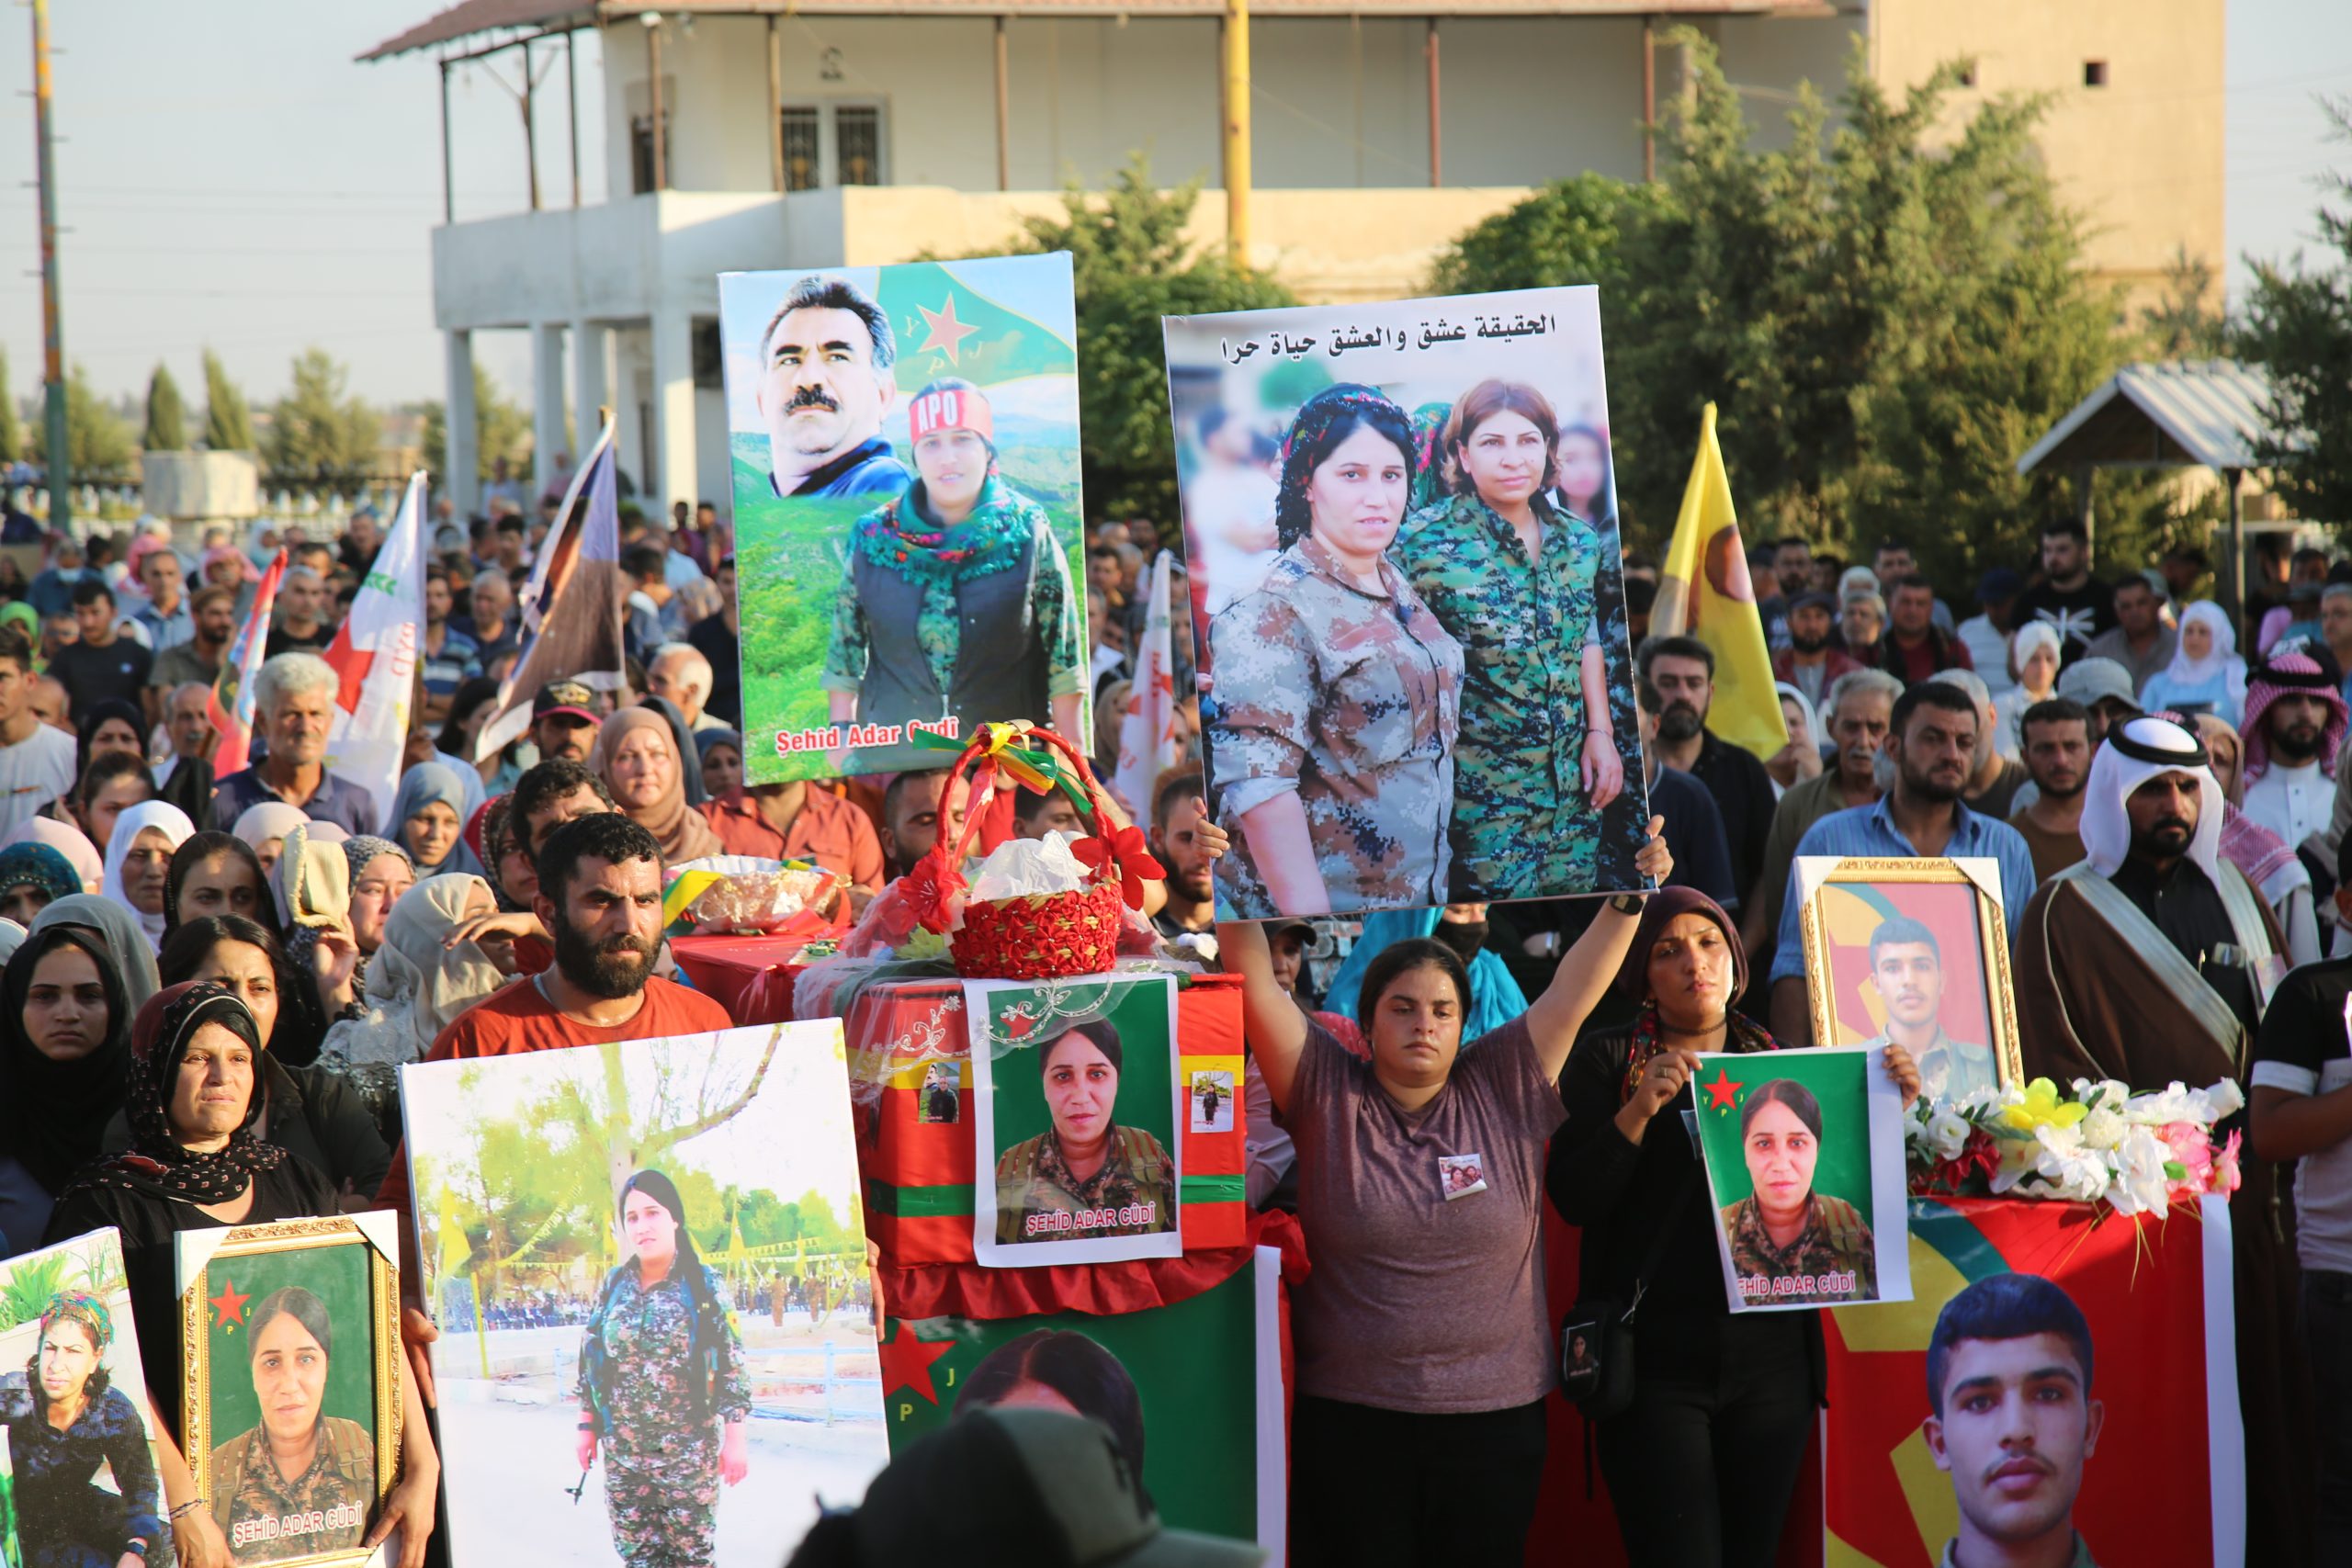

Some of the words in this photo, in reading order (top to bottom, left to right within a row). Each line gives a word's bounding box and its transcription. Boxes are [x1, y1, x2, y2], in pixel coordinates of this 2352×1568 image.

[1329, 325, 1407, 357] والعشق
[1418, 319, 1466, 350] عشق
[1475, 313, 1555, 344] الحقيقة
[905, 315, 921, 338] Y
[927, 355, 944, 376] P
[968, 341, 985, 359] J
[1222, 339, 1260, 365] حرا
[1270, 333, 1317, 360] حياة
[918, 390, 958, 434] APO
[776, 727, 839, 758] Şehîd
[847, 723, 901, 748] Adar
[1721, 1108, 1727, 1117] P
[1026, 1209, 1072, 1236] ŞEHÎD
[1073, 1208, 1117, 1229] ADAR
[1118, 1201, 1156, 1226] CÛDÎ
[1772, 1274, 1816, 1295] ADAR
[1817, 1269, 1856, 1292] CÛDÎ
[208, 1312, 214, 1322] Y
[227, 1325, 234, 1335] P
[245, 1307, 251, 1316] J
[899, 1404, 913, 1421] P
[946, 1368, 955, 1387] J
[232, 1515, 278, 1548] ŞEHÎD
[280, 1511, 324, 1537] ADAR
[326, 1500, 364, 1529] CÛDÎ
